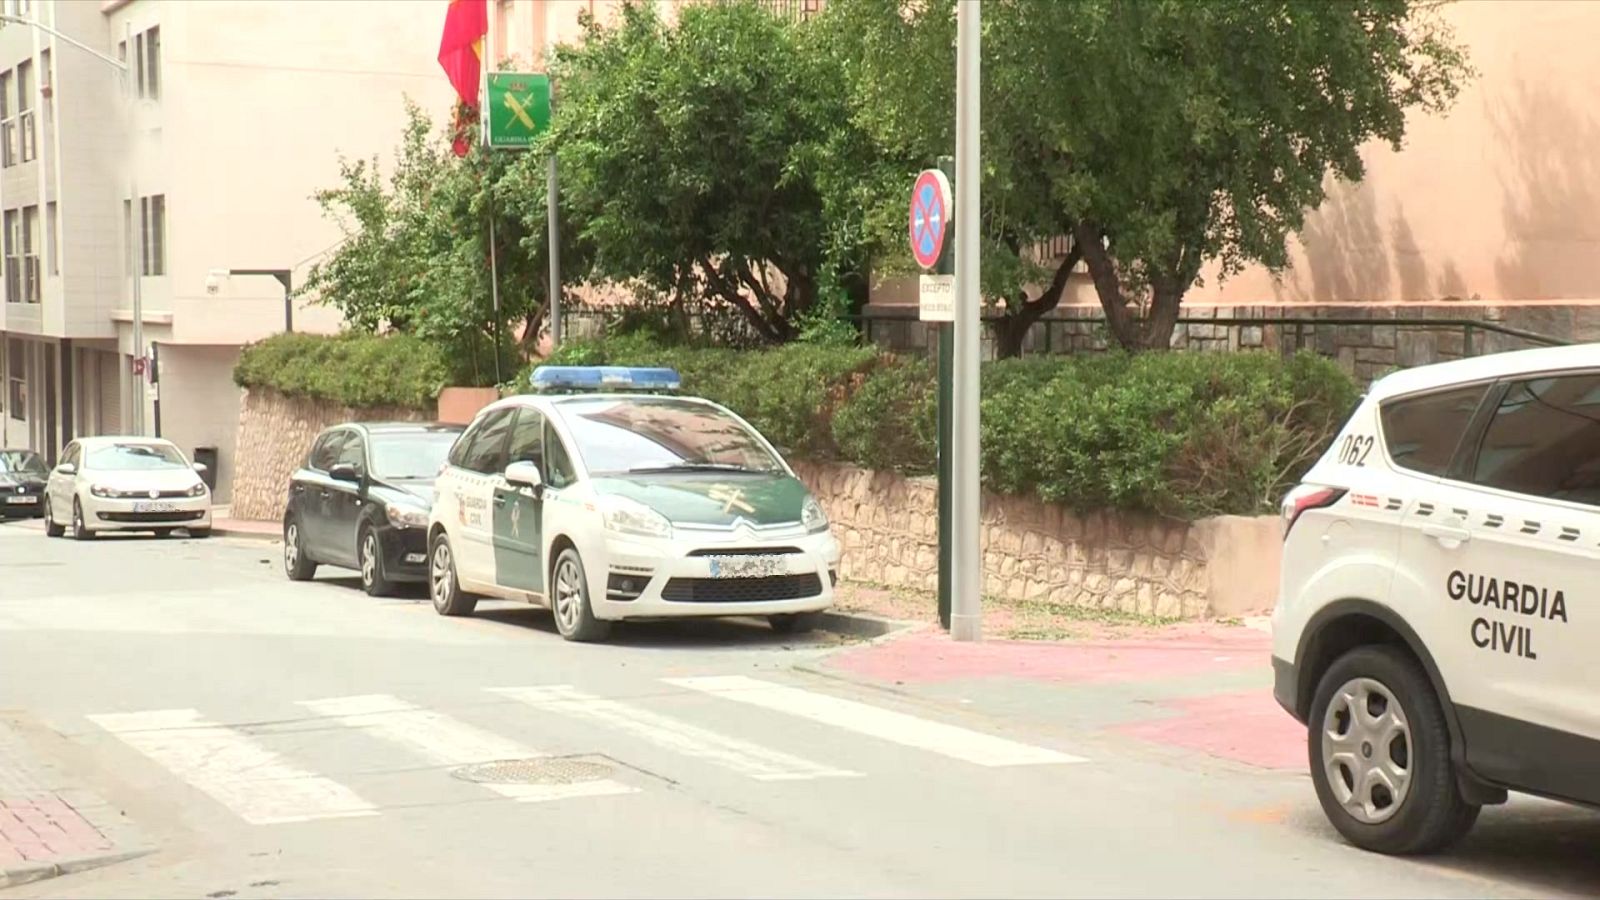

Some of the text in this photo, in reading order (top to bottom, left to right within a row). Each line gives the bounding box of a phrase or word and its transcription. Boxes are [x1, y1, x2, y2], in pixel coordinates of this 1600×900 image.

[921, 282, 951, 294] EXCEPTO
[1337, 433, 1374, 468] 062
[466, 496, 488, 510] GUARDIA
[1446, 569, 1568, 623] GUARDIA
[1470, 617, 1537, 660] CIVIL
